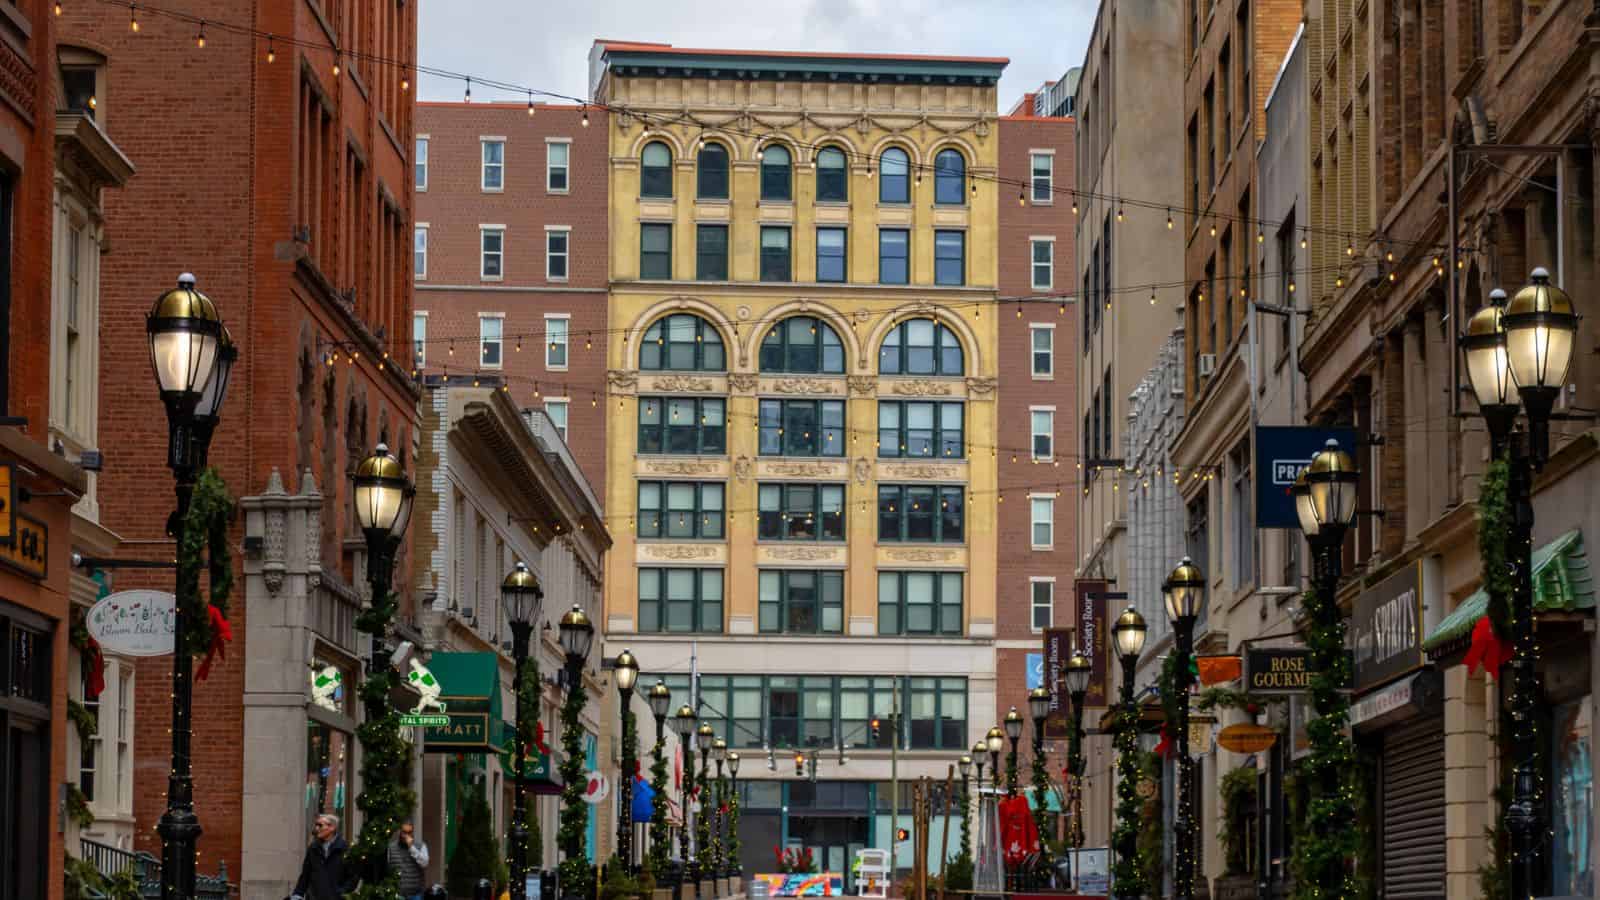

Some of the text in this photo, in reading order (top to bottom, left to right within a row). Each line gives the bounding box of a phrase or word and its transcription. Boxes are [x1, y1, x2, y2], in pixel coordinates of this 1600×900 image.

[1278, 465, 1304, 480] PRA
[1375, 587, 1416, 664] SPIRITS
[1082, 623, 1095, 657] Society
[1271, 657, 1305, 672] ROSE
[400, 717, 447, 725] ITAL SPIRITS
[436, 724, 481, 736] PRATT
